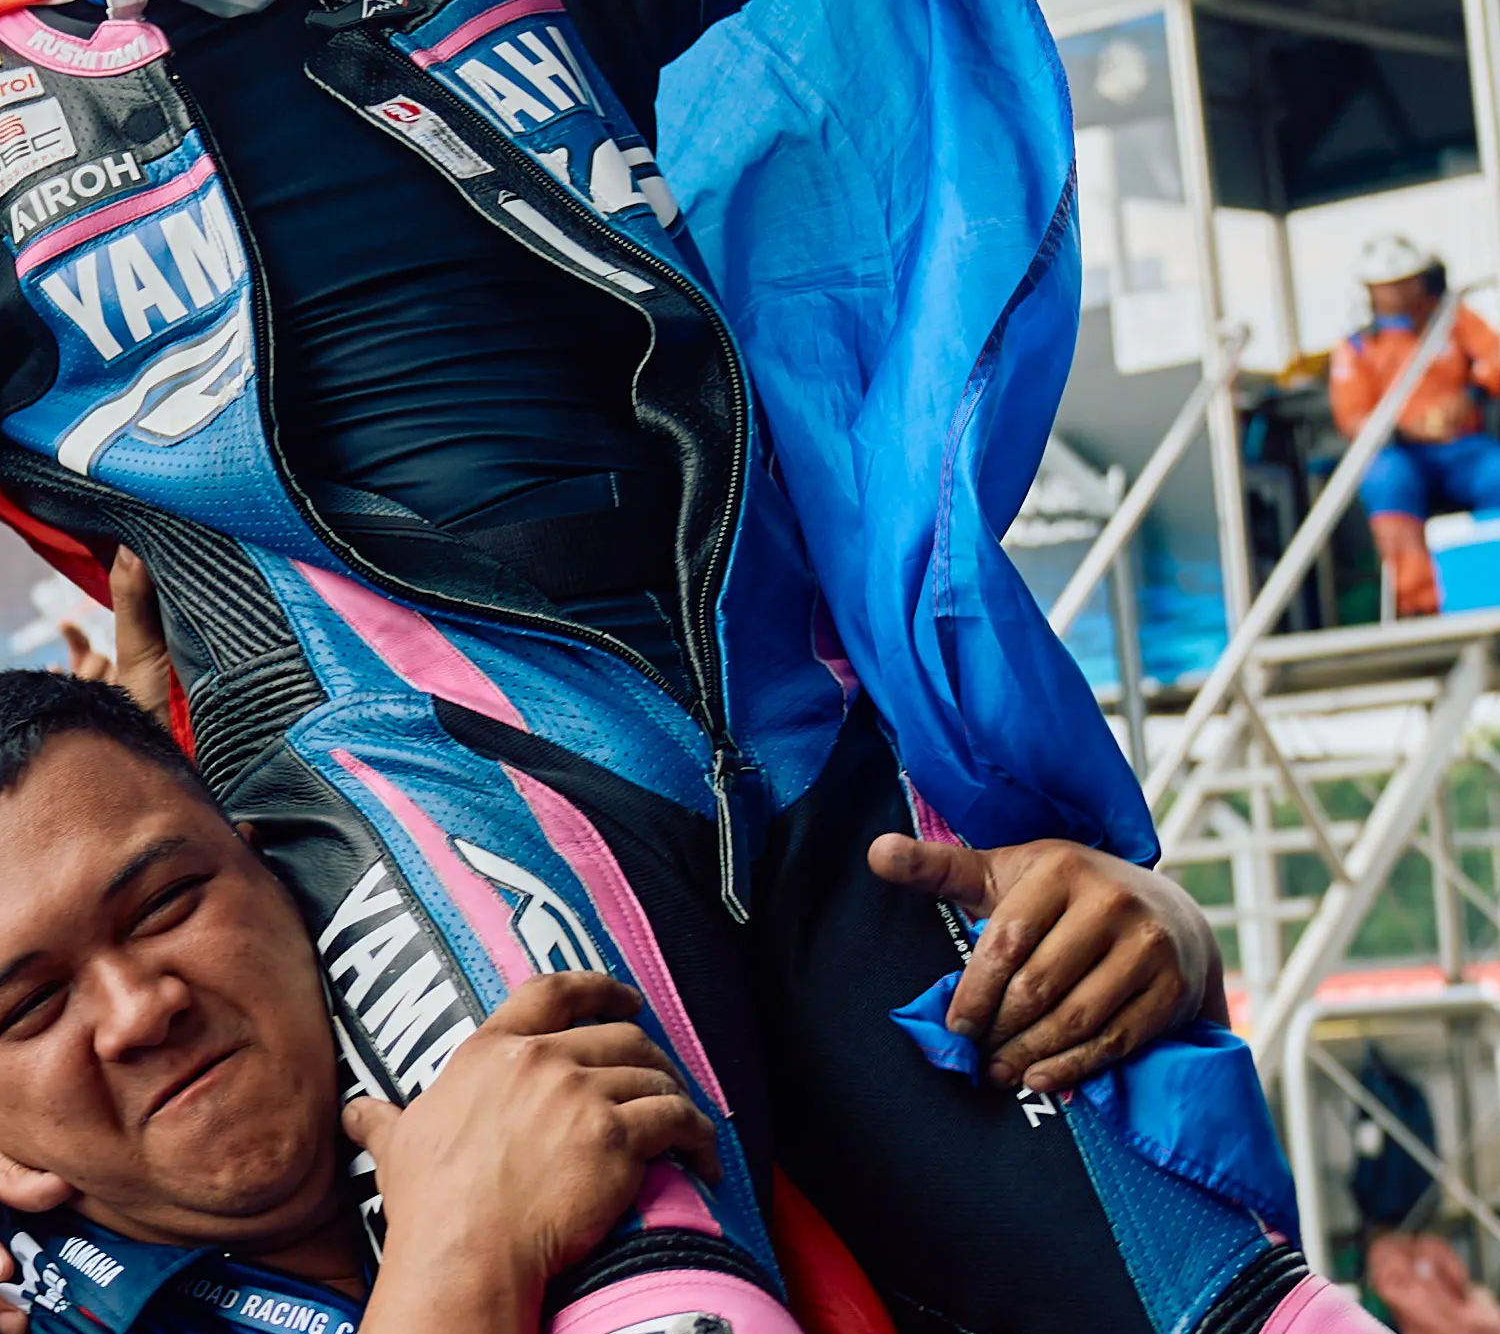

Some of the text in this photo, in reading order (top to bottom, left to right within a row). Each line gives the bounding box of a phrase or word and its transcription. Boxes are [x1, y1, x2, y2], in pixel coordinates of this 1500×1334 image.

[9, 151, 142, 245] AIROH
[39, 186, 247, 362] YAM
[316, 860, 478, 1101] YAMA
[57, 1236, 125, 1288] YAMAHA
